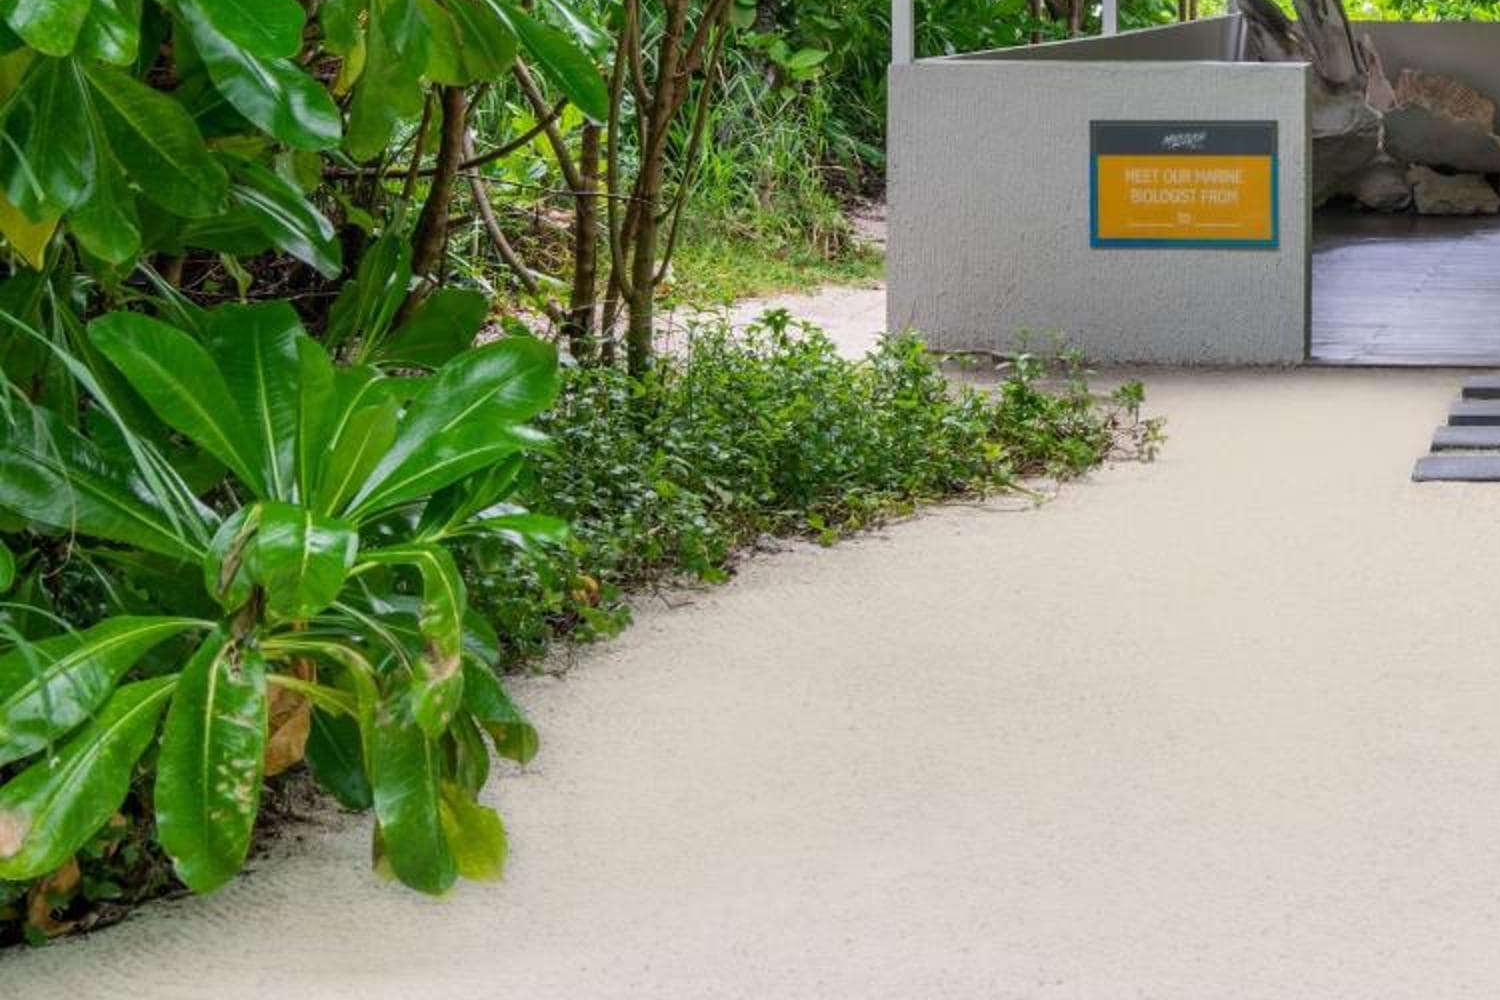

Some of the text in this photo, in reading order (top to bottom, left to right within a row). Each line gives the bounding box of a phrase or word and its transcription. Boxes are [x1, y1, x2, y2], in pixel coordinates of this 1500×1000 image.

[1125, 168, 1243, 184] MEET OUR MARINE
[1130, 187, 1240, 204] BIOLOGIST FROM
